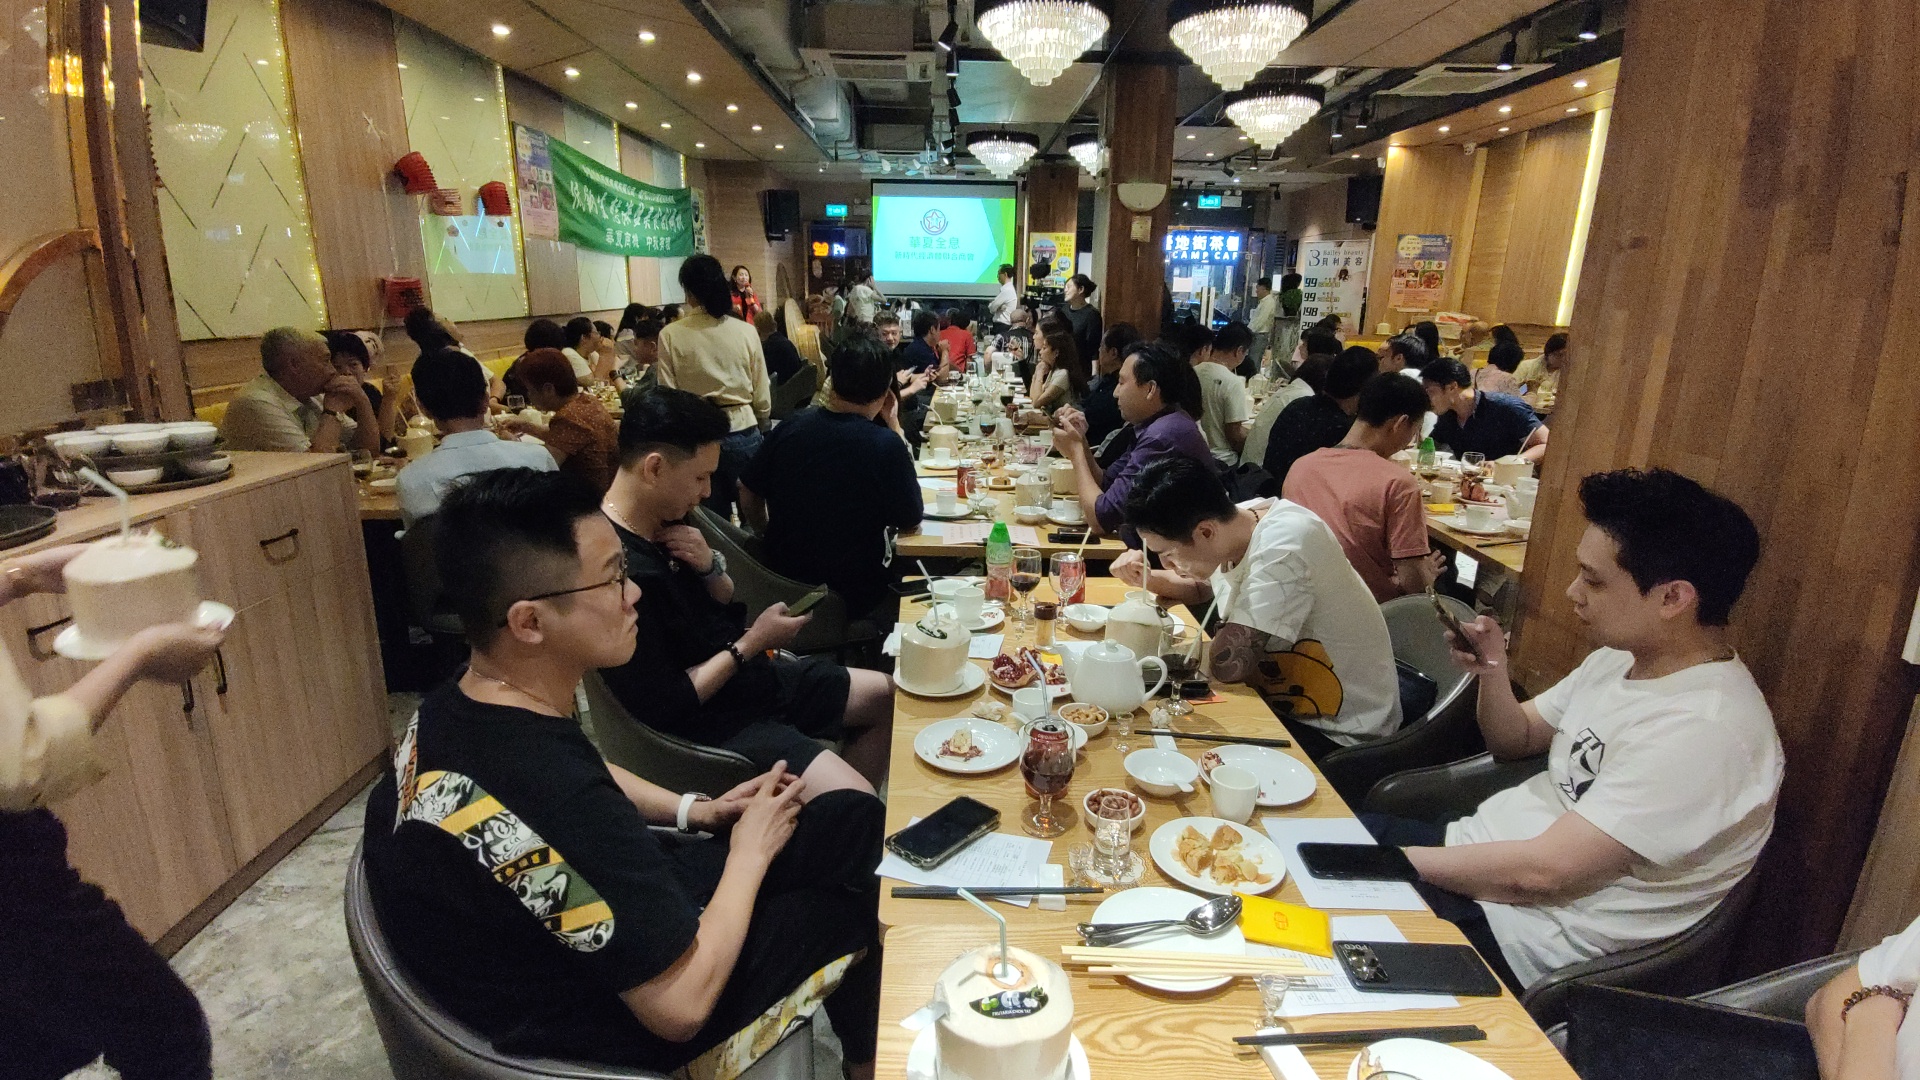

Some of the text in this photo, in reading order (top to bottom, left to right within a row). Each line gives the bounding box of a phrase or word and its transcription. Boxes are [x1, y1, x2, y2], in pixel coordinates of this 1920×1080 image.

[909, 236, 960, 249] 華夏全息
[1172, 251, 1209, 260] CAMP
[1304, 278, 1317, 287] 99
[1303, 292, 1316, 302] 99
[1302, 307, 1318, 316] 198
